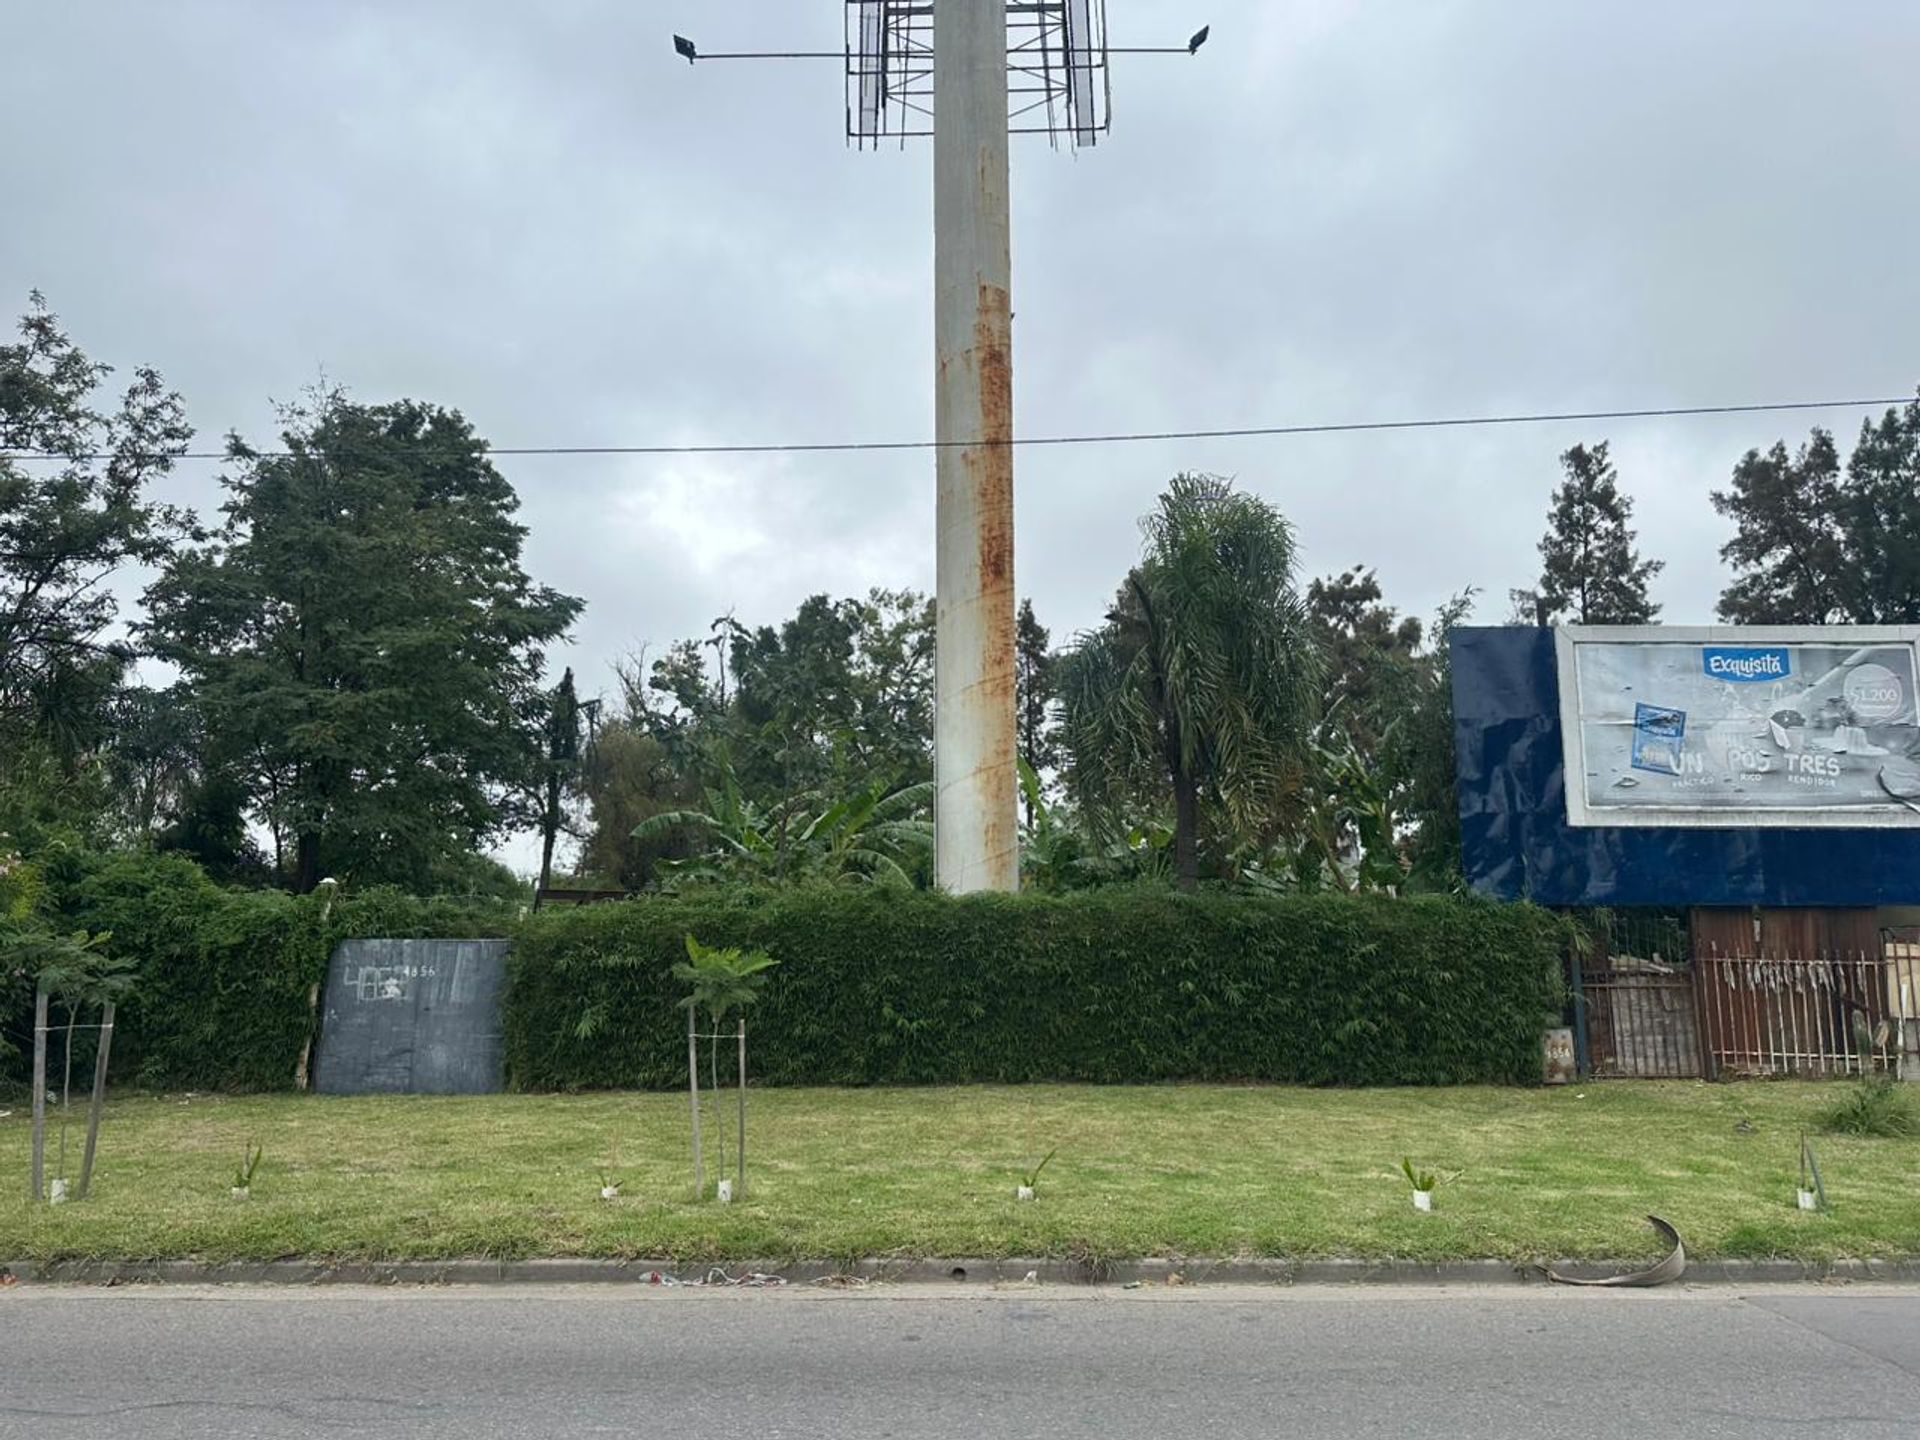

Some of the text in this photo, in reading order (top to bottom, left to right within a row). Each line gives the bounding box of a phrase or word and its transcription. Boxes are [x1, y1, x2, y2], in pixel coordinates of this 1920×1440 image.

[1709, 654, 1784, 678] Exquisita
[1669, 752, 1704, 775] UN
[1784, 753, 1840, 777] TRES
[1740, 774, 1763, 782] RICO
[404, 965, 436, 977] 4856
